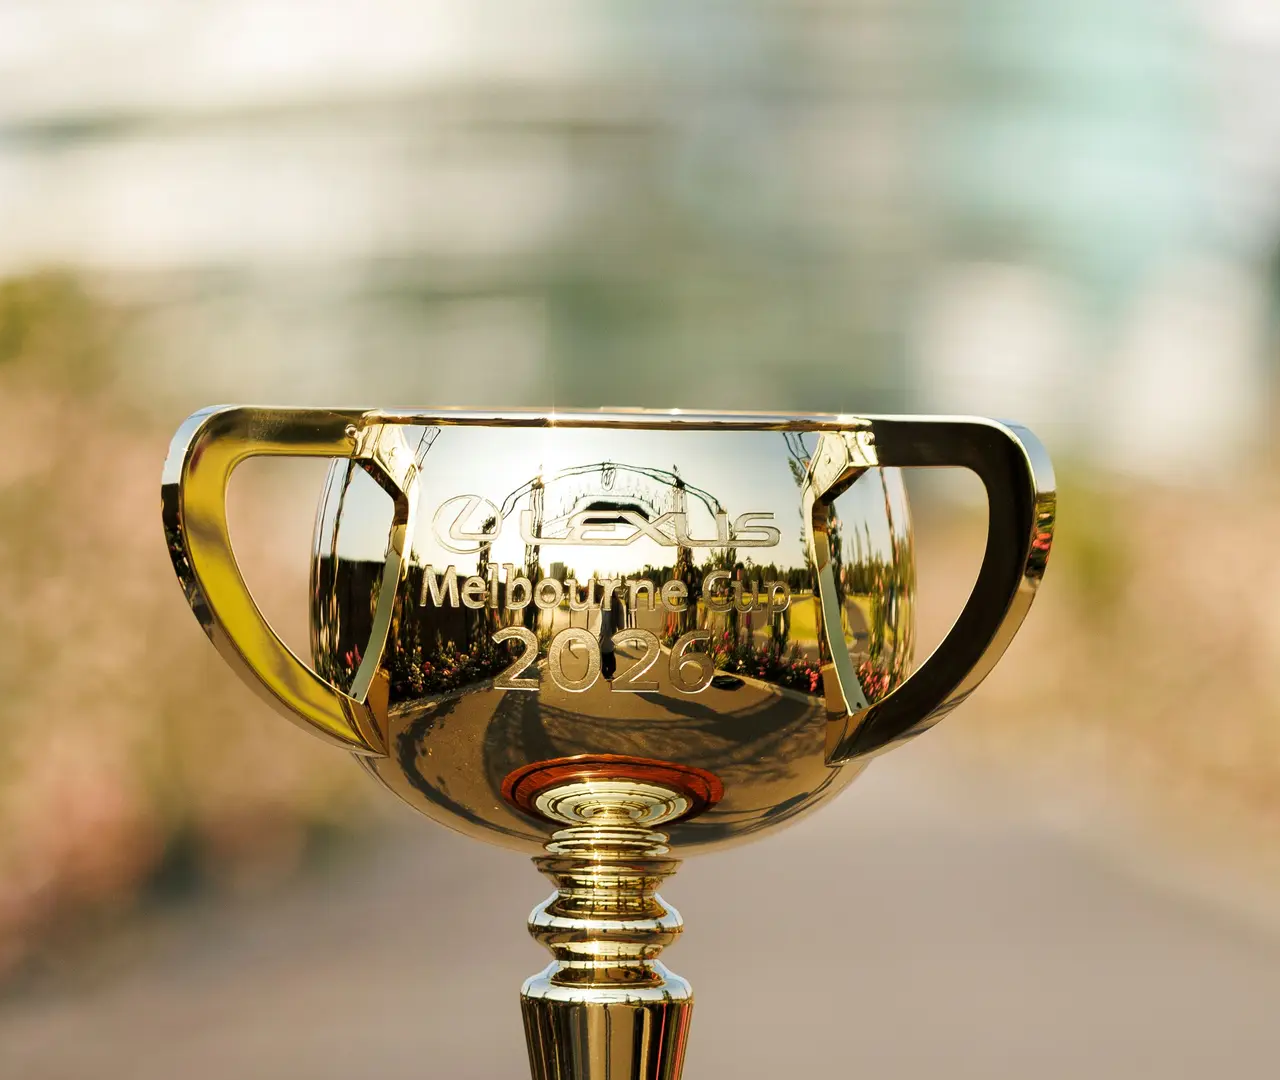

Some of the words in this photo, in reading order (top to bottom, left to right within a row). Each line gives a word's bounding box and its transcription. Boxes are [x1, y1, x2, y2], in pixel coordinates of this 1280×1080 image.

[520, 508, 782, 548] LEXUS
[420, 562, 689, 613] Melbourne
[701, 569, 792, 628] Cup
[491, 625, 716, 694] 2026
